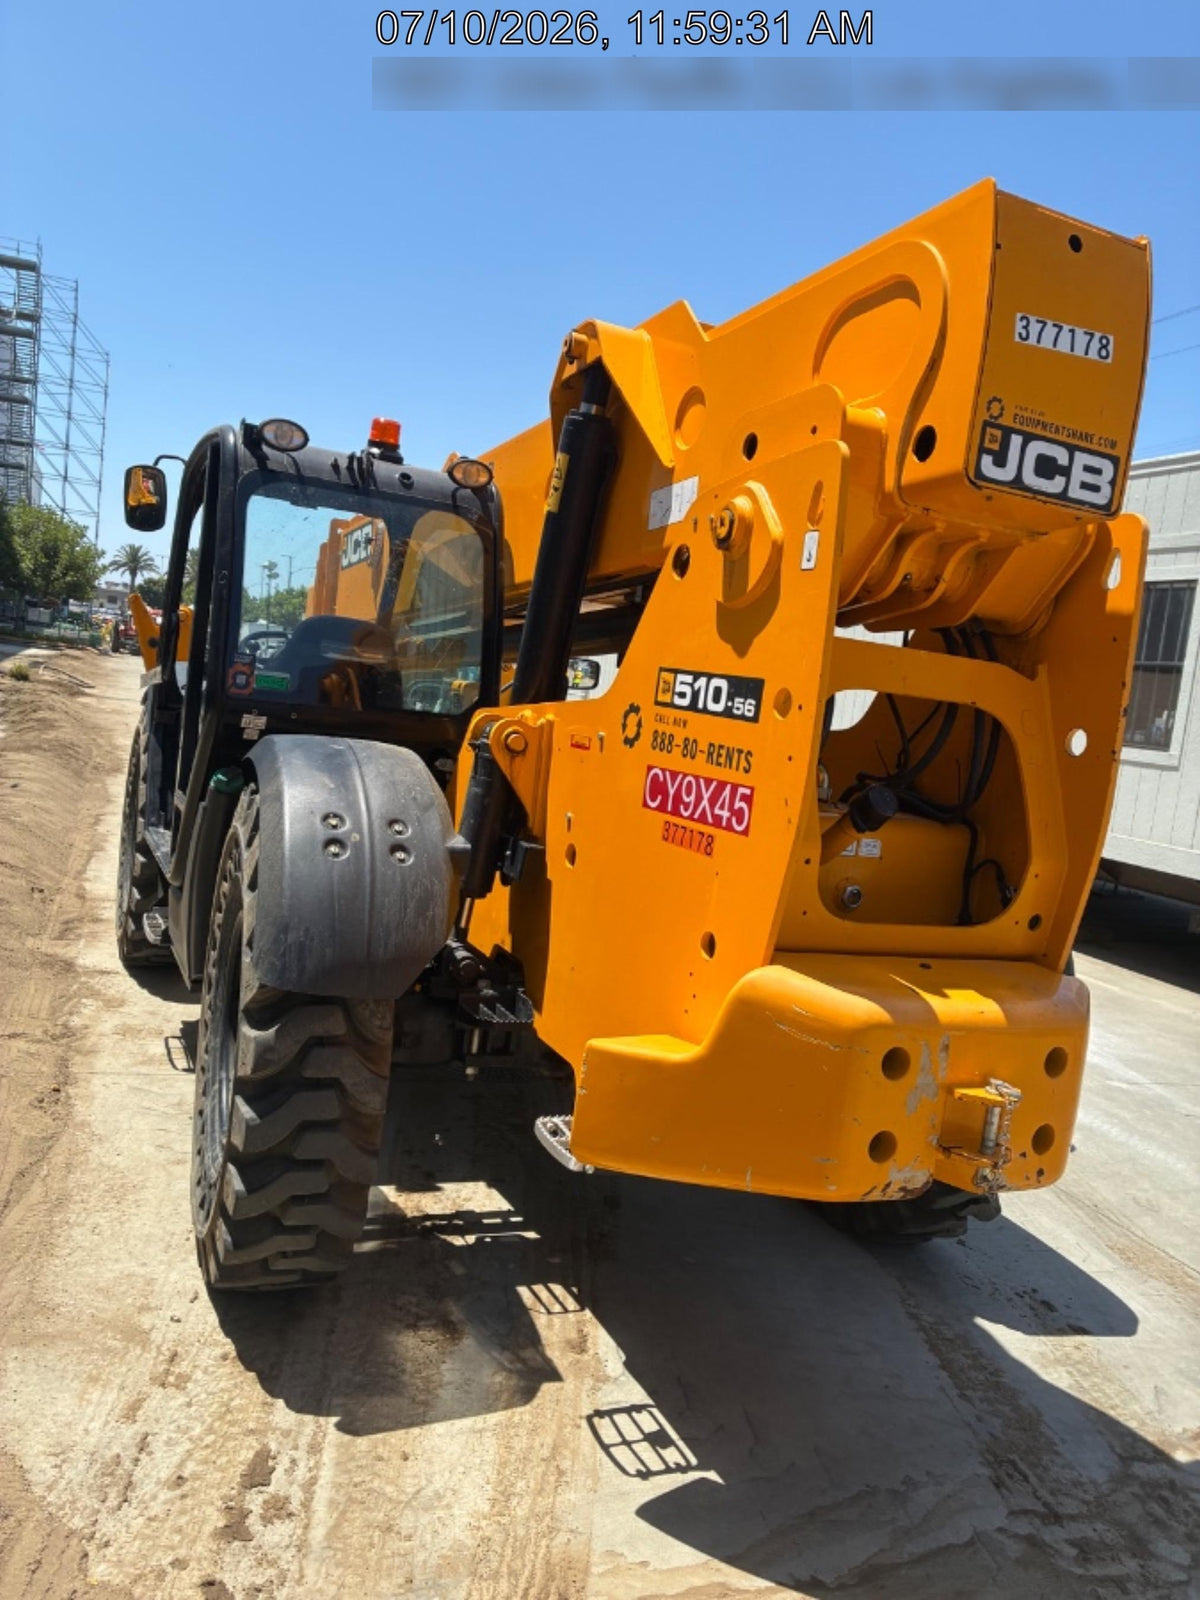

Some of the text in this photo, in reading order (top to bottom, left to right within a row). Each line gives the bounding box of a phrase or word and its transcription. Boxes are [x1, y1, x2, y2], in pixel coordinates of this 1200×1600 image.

[1017, 315, 1112, 361] 377178
[980, 433, 1115, 506] JCB
[651, 729, 753, 775] 888-80-RENTS
[644, 767, 752, 832] CY9X45
[661, 820, 715, 857] 377178
